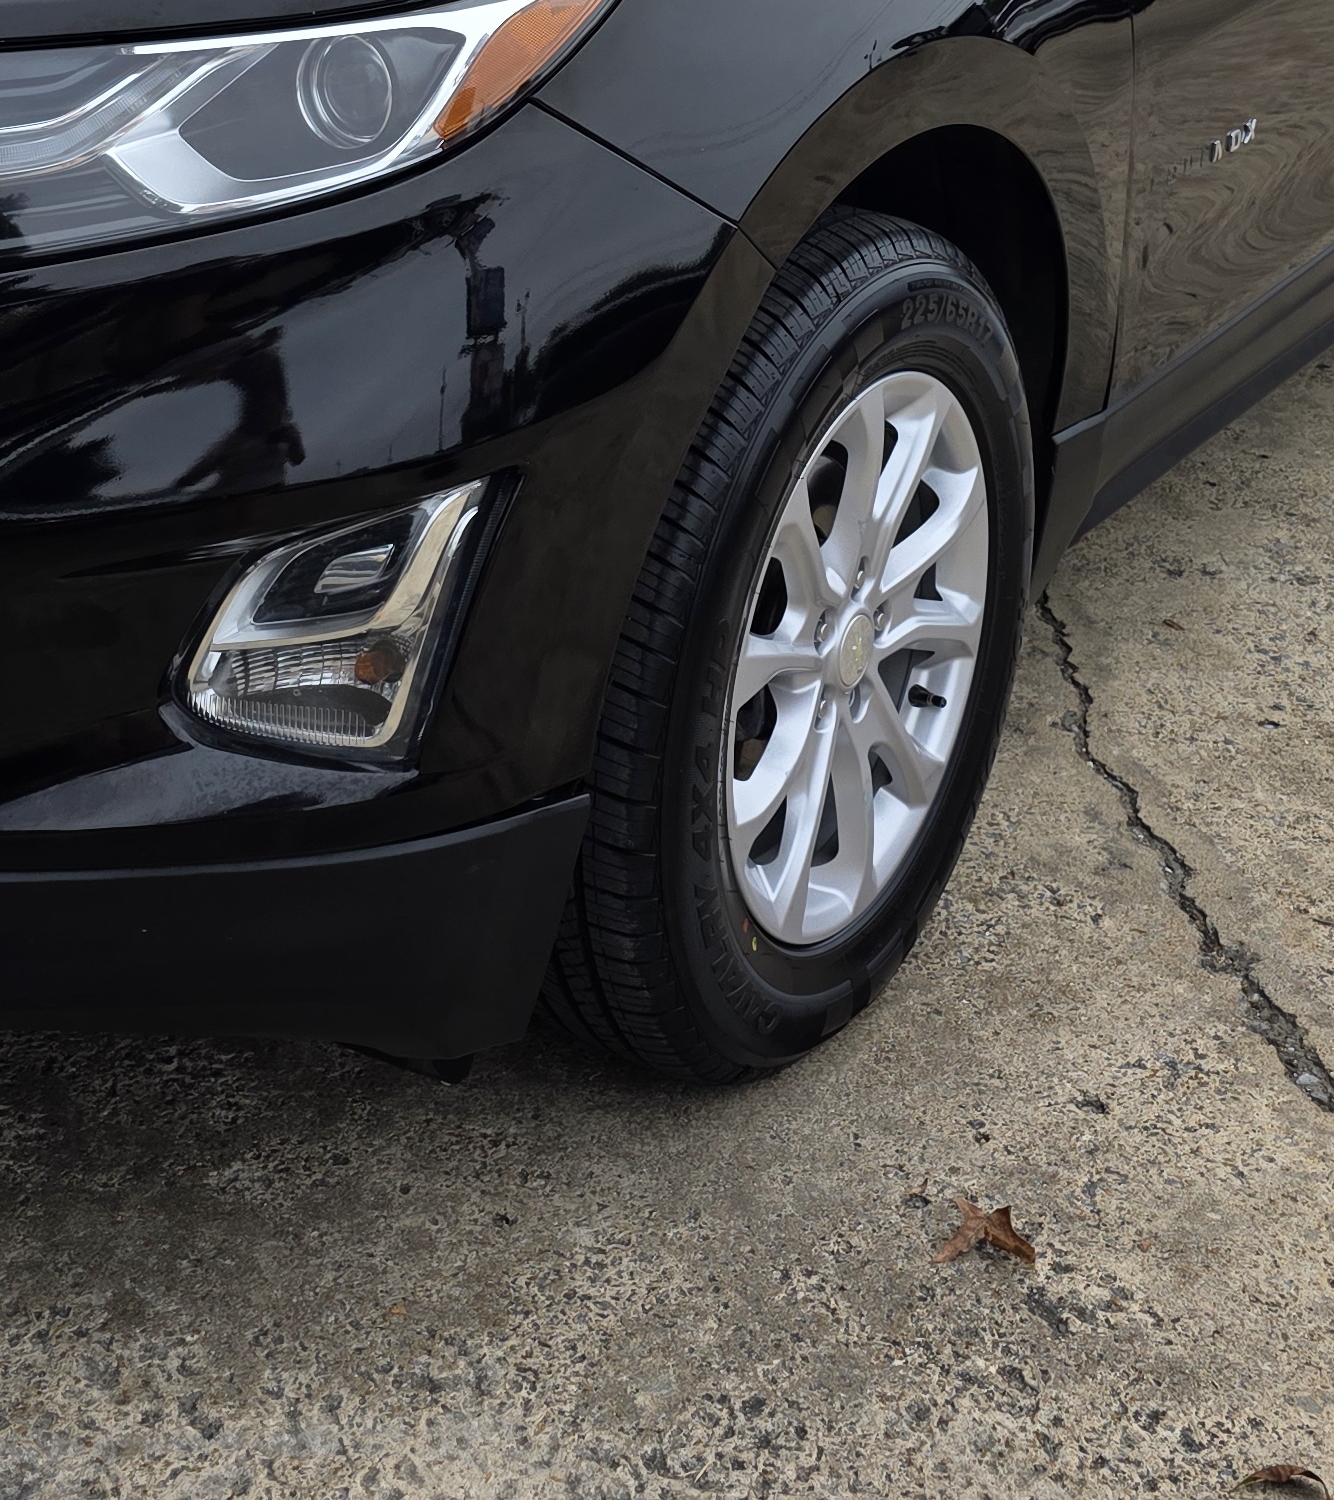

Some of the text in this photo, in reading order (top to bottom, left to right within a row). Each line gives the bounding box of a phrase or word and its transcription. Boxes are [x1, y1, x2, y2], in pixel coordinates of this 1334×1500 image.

[901, 293, 994, 349] 225/65R17
[691, 743, 714, 863] 4X4
[693, 884, 782, 1035] CAVALRY
